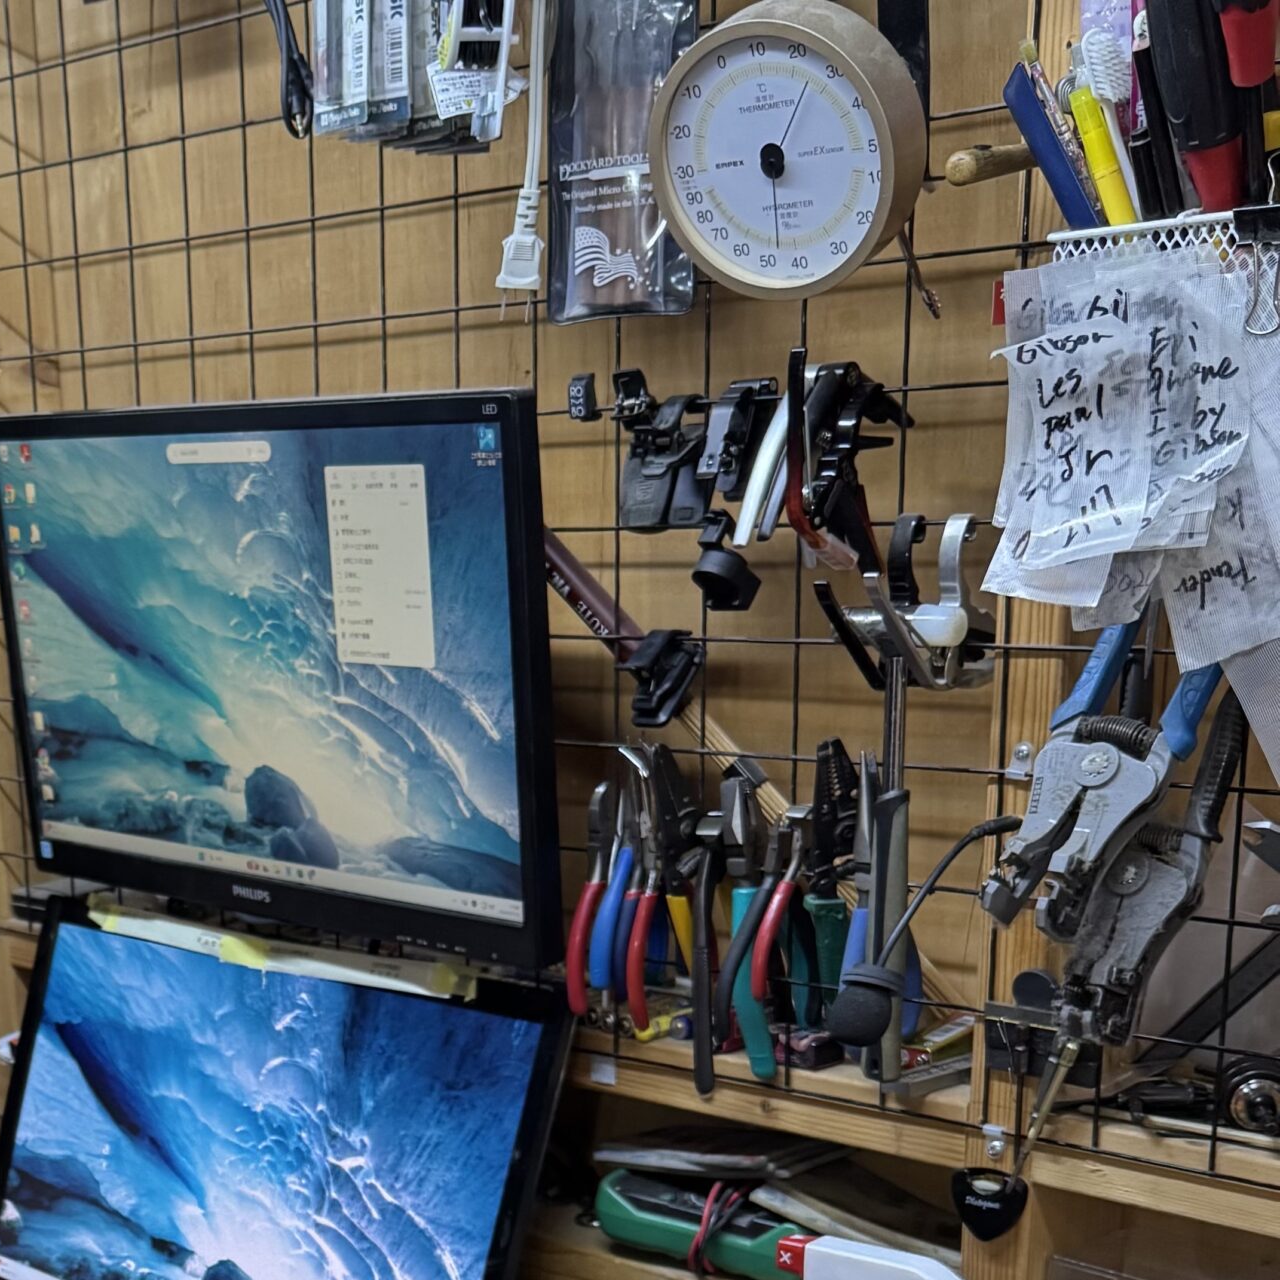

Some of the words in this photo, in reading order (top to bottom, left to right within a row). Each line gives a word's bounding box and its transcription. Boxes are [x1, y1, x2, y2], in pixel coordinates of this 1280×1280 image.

[749, 42, 766, 58] 10
[788, 43, 807, 59] 20
[717, 55, 727, 70] 0
[680, 85, 702, 100] -10
[739, 99, 795, 114] THERMOMETER
[852, 97, 866, 110] 4
[670, 125, 691, 140] -20
[560, 157, 613, 181] DOCKYARD
[673, 165, 694, 179] -30
[599, 185, 620, 196] Micro
[686, 191, 703, 205] 90
[697, 210, 713, 224] 80
[711, 227, 729, 242] 70
[733, 243, 750, 258] 60
[830, 241, 848, 255] 30
[760, 254, 776, 268] 50
[791, 256, 808, 270] 40
[482, 404, 497, 415] LED
[232, 884, 271, 903] PHILIPS
